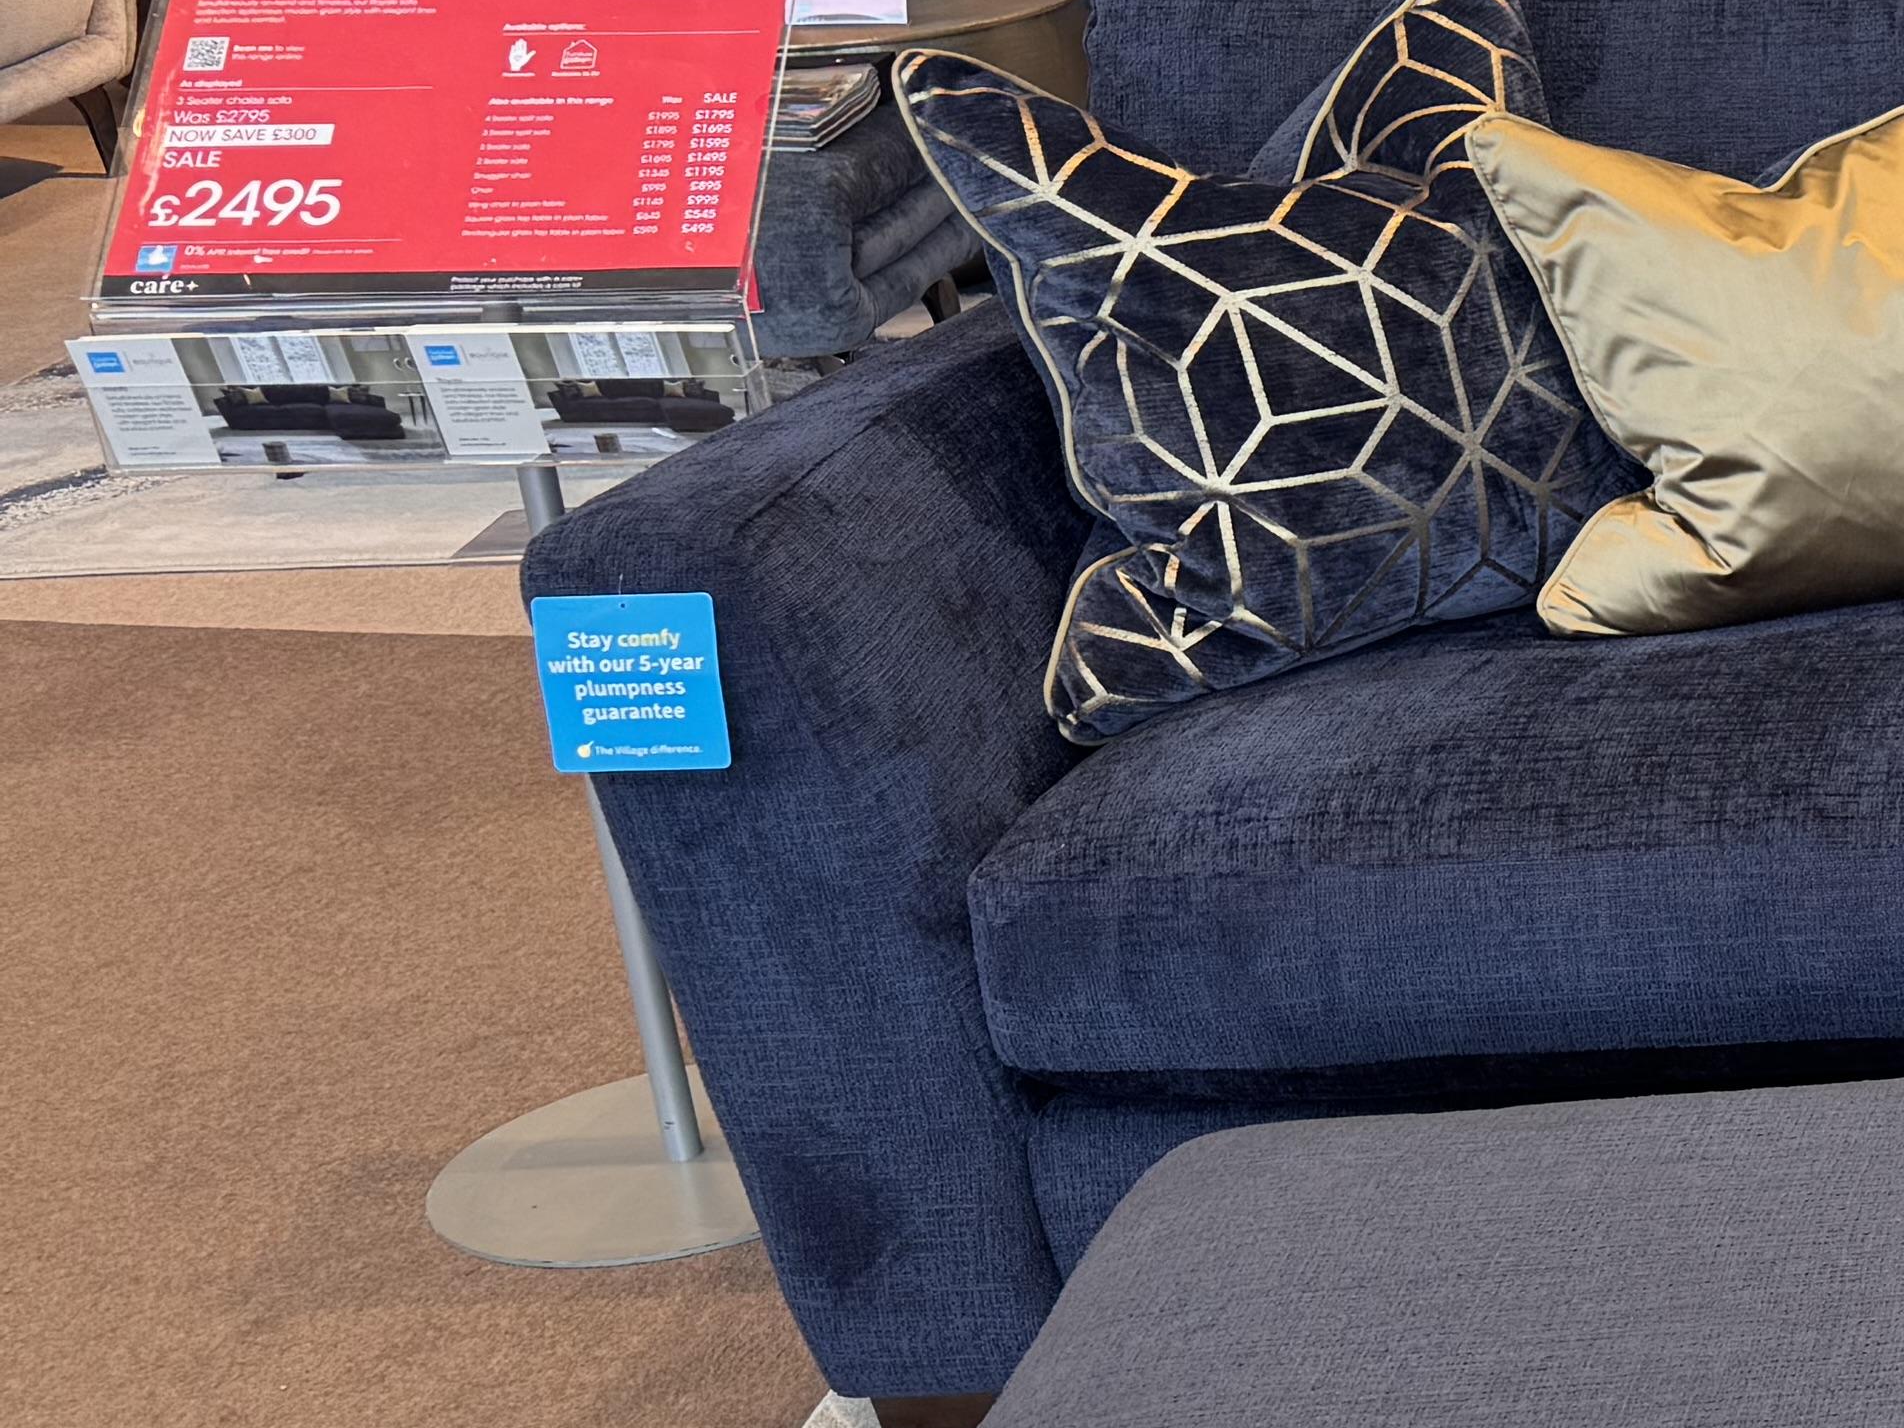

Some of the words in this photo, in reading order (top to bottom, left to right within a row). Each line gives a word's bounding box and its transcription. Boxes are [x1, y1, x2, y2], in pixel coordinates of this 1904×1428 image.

[703, 92, 737, 104] SALE
[173, 110, 211, 125] Was
[215, 109, 271, 124] £2795
[695, 109, 736, 120] £1795
[168, 129, 215, 143] NOW
[220, 128, 266, 142] SAVE
[272, 128, 318, 142] £300
[692, 123, 733, 135] £1695
[690, 138, 730, 149] £1595
[162, 150, 222, 168] SALE
[685, 166, 725, 177] £1195
[148, 178, 343, 227] £2495
[567, 631, 613, 652] Stay
[618, 628, 681, 650] comfy
[548, 655, 595, 674] with
[599, 658, 635, 673] our
[639, 654, 704, 675] 5-year
[574, 679, 686, 700] plumpness
[582, 702, 686, 725] guarantee
